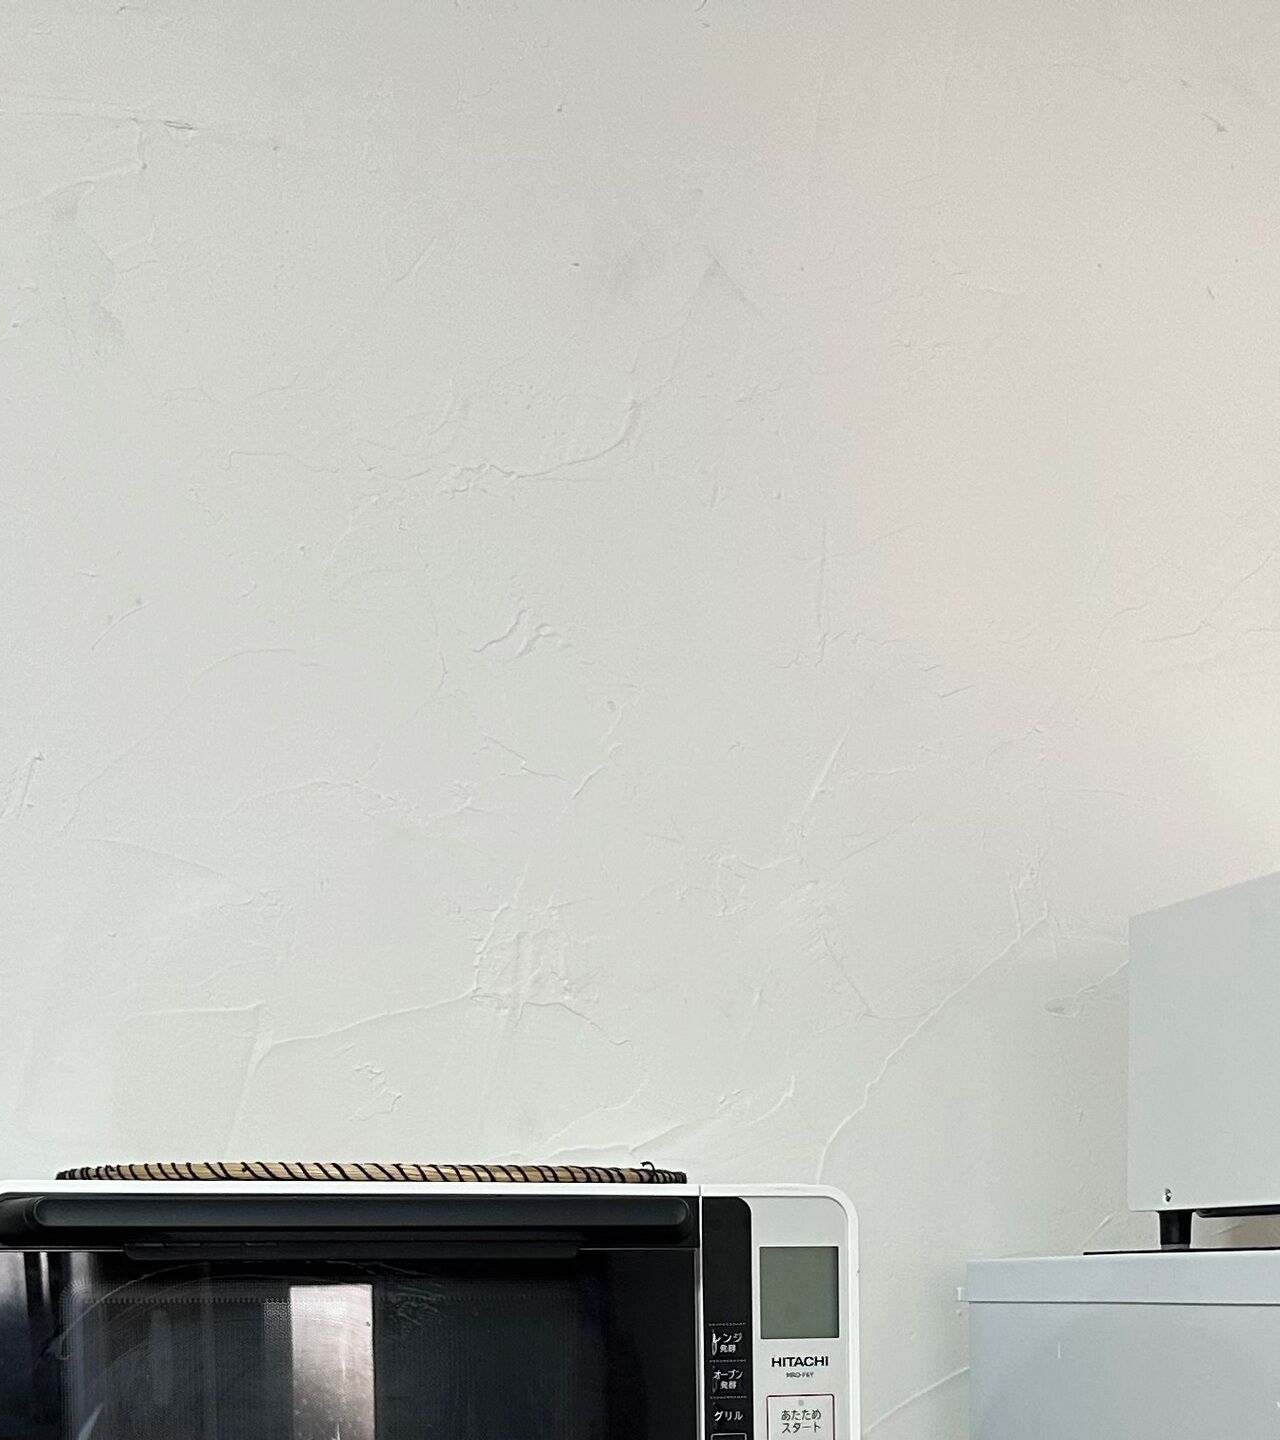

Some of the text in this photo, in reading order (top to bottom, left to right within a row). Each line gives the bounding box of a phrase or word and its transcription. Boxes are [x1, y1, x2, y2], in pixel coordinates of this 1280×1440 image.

[713, 1332, 743, 1343] レンジ
[720, 1344, 736, 1353] 発酵
[771, 1356, 829, 1368] HITACHI
[713, 1369, 743, 1380] オーブン
[720, 1381, 737, 1390] 発酵
[713, 1411, 744, 1422] グリル
[781, 1409, 822, 1421] あたため
[781, 1422, 822, 1434] スタート
